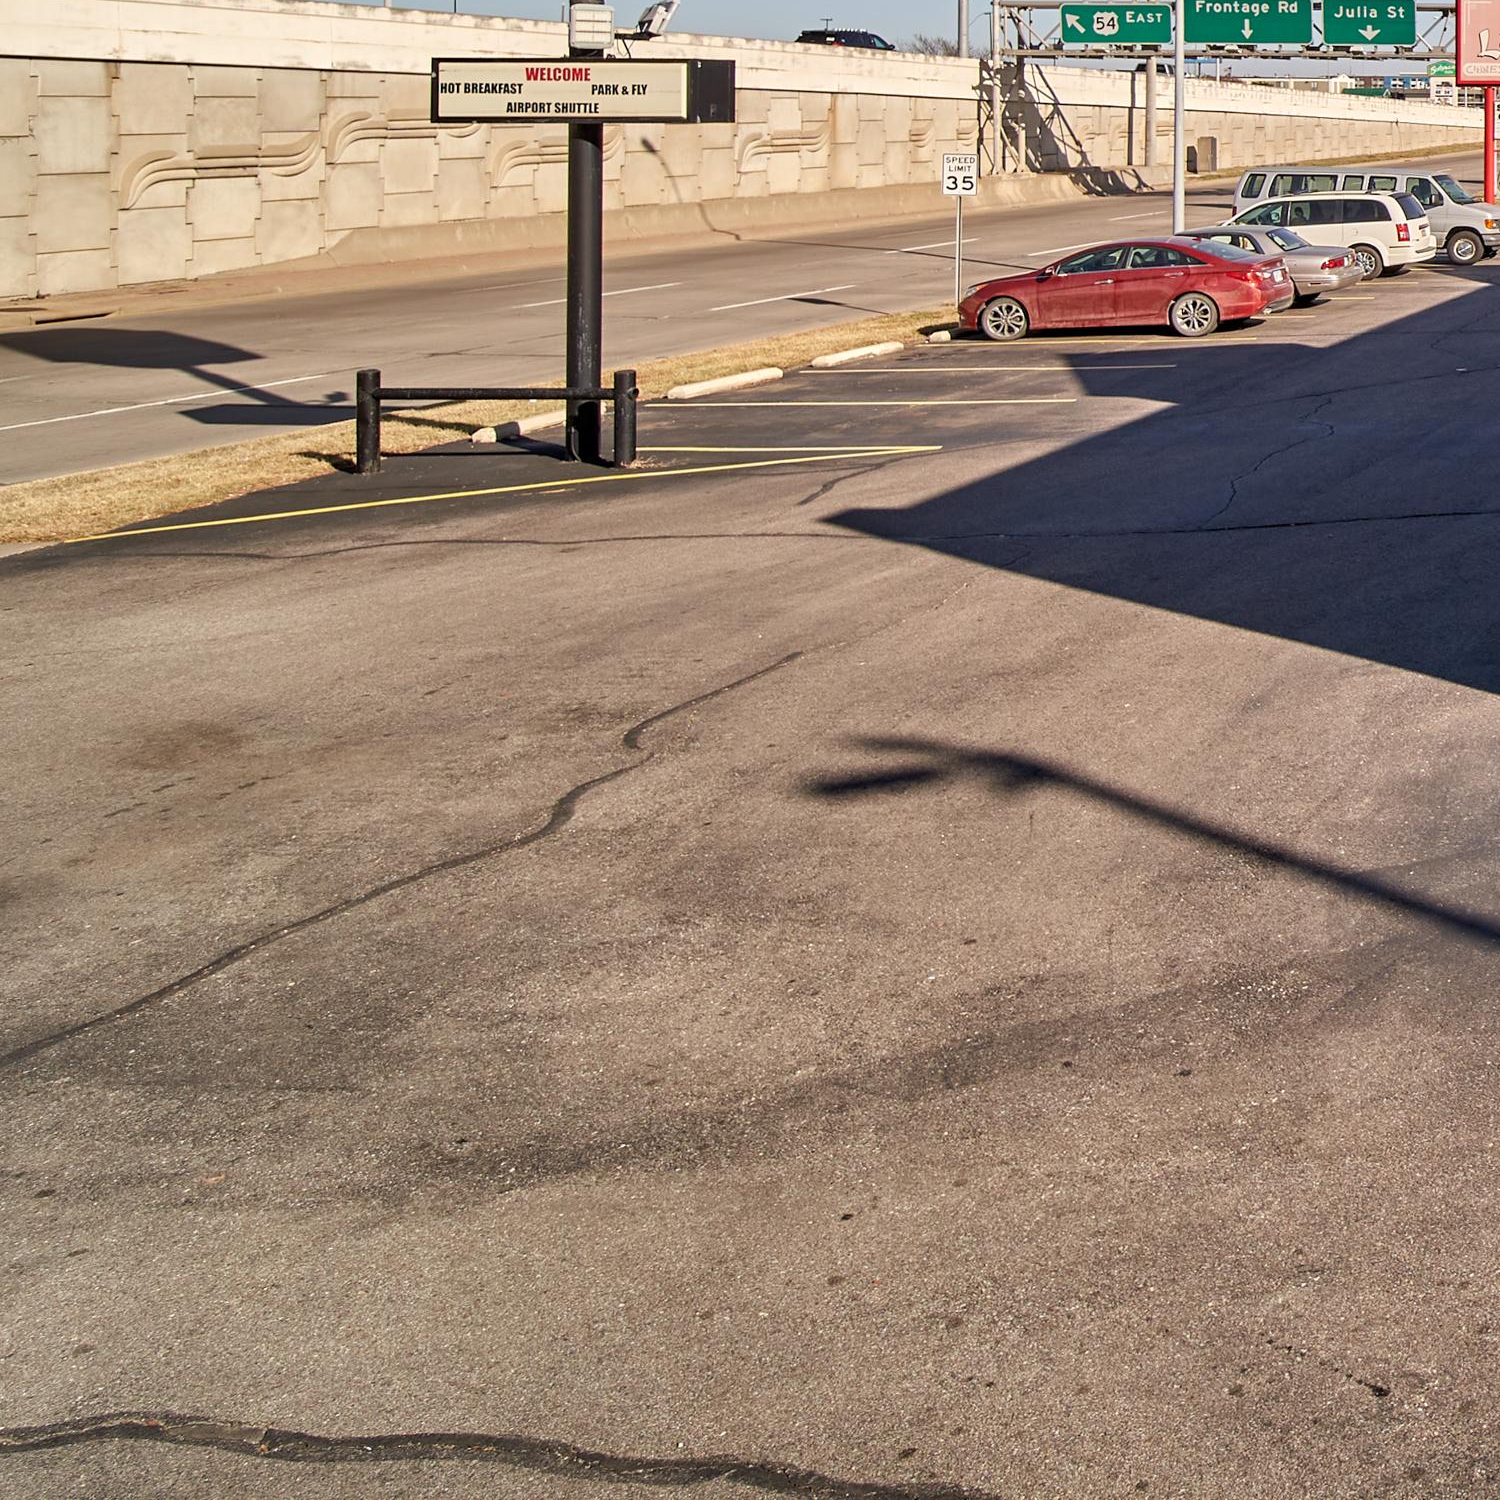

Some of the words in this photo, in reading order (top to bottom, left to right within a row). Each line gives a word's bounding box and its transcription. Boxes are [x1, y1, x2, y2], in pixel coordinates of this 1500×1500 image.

[1196, 0, 1269, 16] Frontage
[1278, 1, 1298, 13] Rd
[1334, 5, 1377, 18] Julia
[1387, 6, 1405, 18] St
[1096, 16, 1118, 30] 54
[1126, 11, 1162, 24] EAST
[525, 68, 591, 82] WELCOME
[440, 82, 460, 94] HOT
[464, 83, 524, 94] BREAKFAST
[591, 84, 618, 95] PARK
[621, 85, 629, 95] &
[632, 84, 647, 95] FLY
[506, 102, 551, 113] AIRPORT
[554, 102, 599, 114] SHUTTLE
[946, 176, 974, 190] 35
